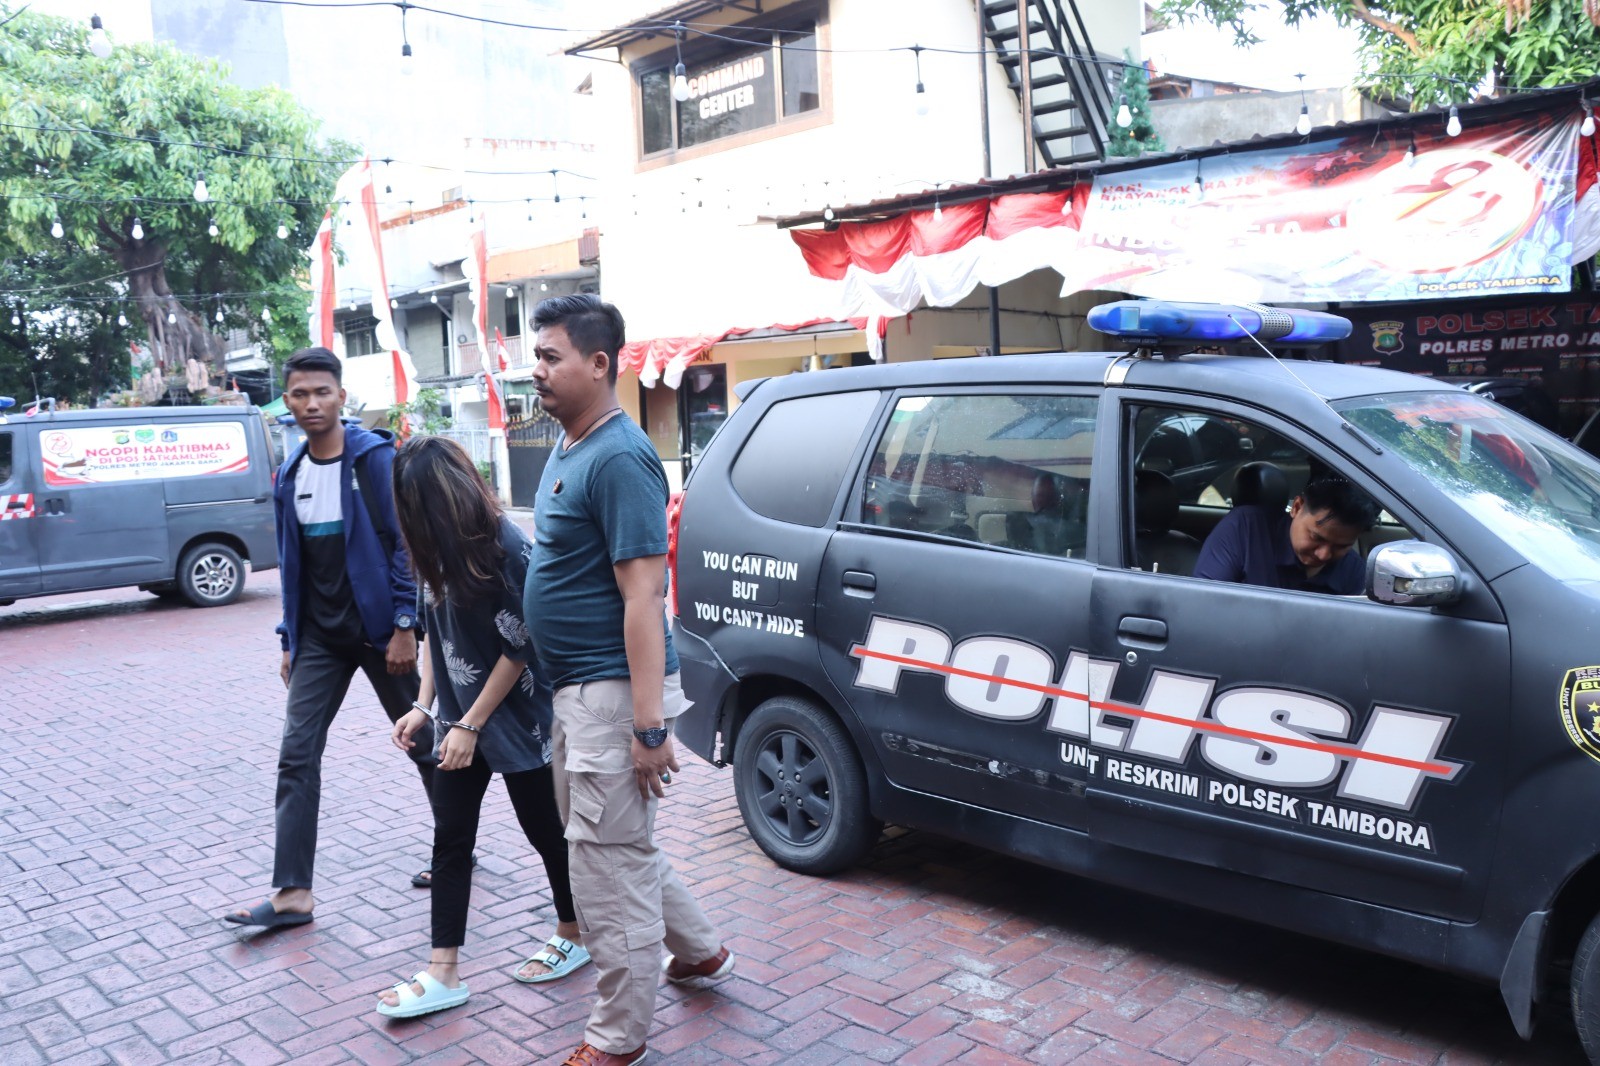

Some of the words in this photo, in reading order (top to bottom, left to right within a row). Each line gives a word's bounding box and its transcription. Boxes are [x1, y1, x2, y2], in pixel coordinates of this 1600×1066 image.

[687, 56, 764, 99] COMMAND
[699, 85, 755, 119] CENTER
[1418, 280, 1479, 293] POLSEK
[1483, 276, 1561, 289] TAMBORA
[1417, 305, 1557, 336] POLSEK
[1420, 338, 1494, 355] POLRES
[1500, 333, 1570, 350] METRO
[85, 446, 138, 457] NGOPI
[144, 442, 231, 454] KAMTIBMAS
[116, 455, 139, 463] POS
[143, 452, 218, 462] SATKAMLING
[702, 550, 729, 571] YOU
[732, 555, 762, 576] CAN
[765, 559, 798, 581] RUN
[732, 580, 759, 601] BUT
[695, 601, 719, 622] YOU
[722, 606, 763, 630] CAN'T
[766, 614, 804, 638] HIDE
[1562, 688, 1570, 706] UNIT
[851, 614, 1461, 812] POLISI
[1563, 708, 1584, 745] RESERSE
[1107, 758, 1199, 797] RESKRIM
[1209, 780, 1299, 819] POLSEK
[1307, 801, 1432, 850] TAMBORA
